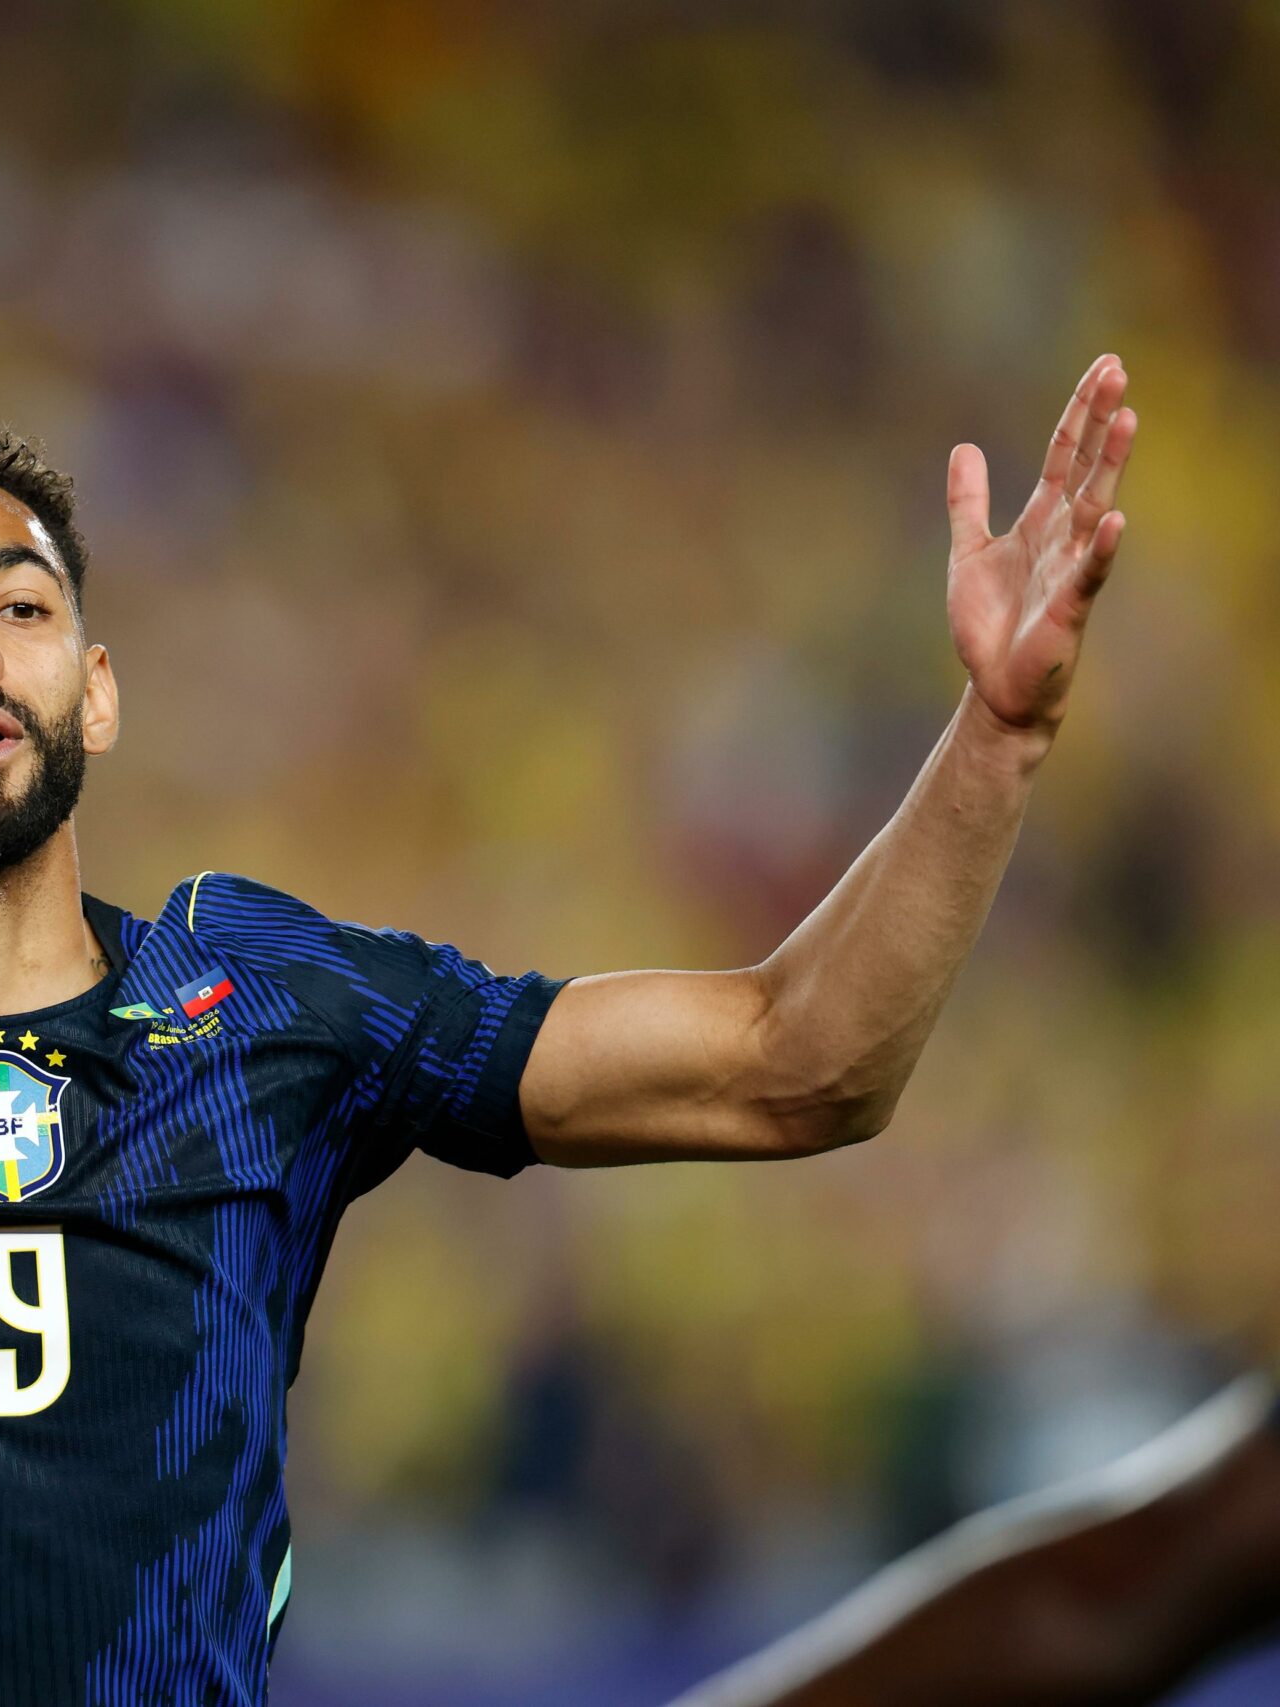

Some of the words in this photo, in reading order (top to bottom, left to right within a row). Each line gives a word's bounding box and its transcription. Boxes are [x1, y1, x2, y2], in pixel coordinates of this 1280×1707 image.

[187, 1023, 198, 1031] de
[198, 1009, 220, 1024] 2026
[206, 1025, 223, 1038] EUA
